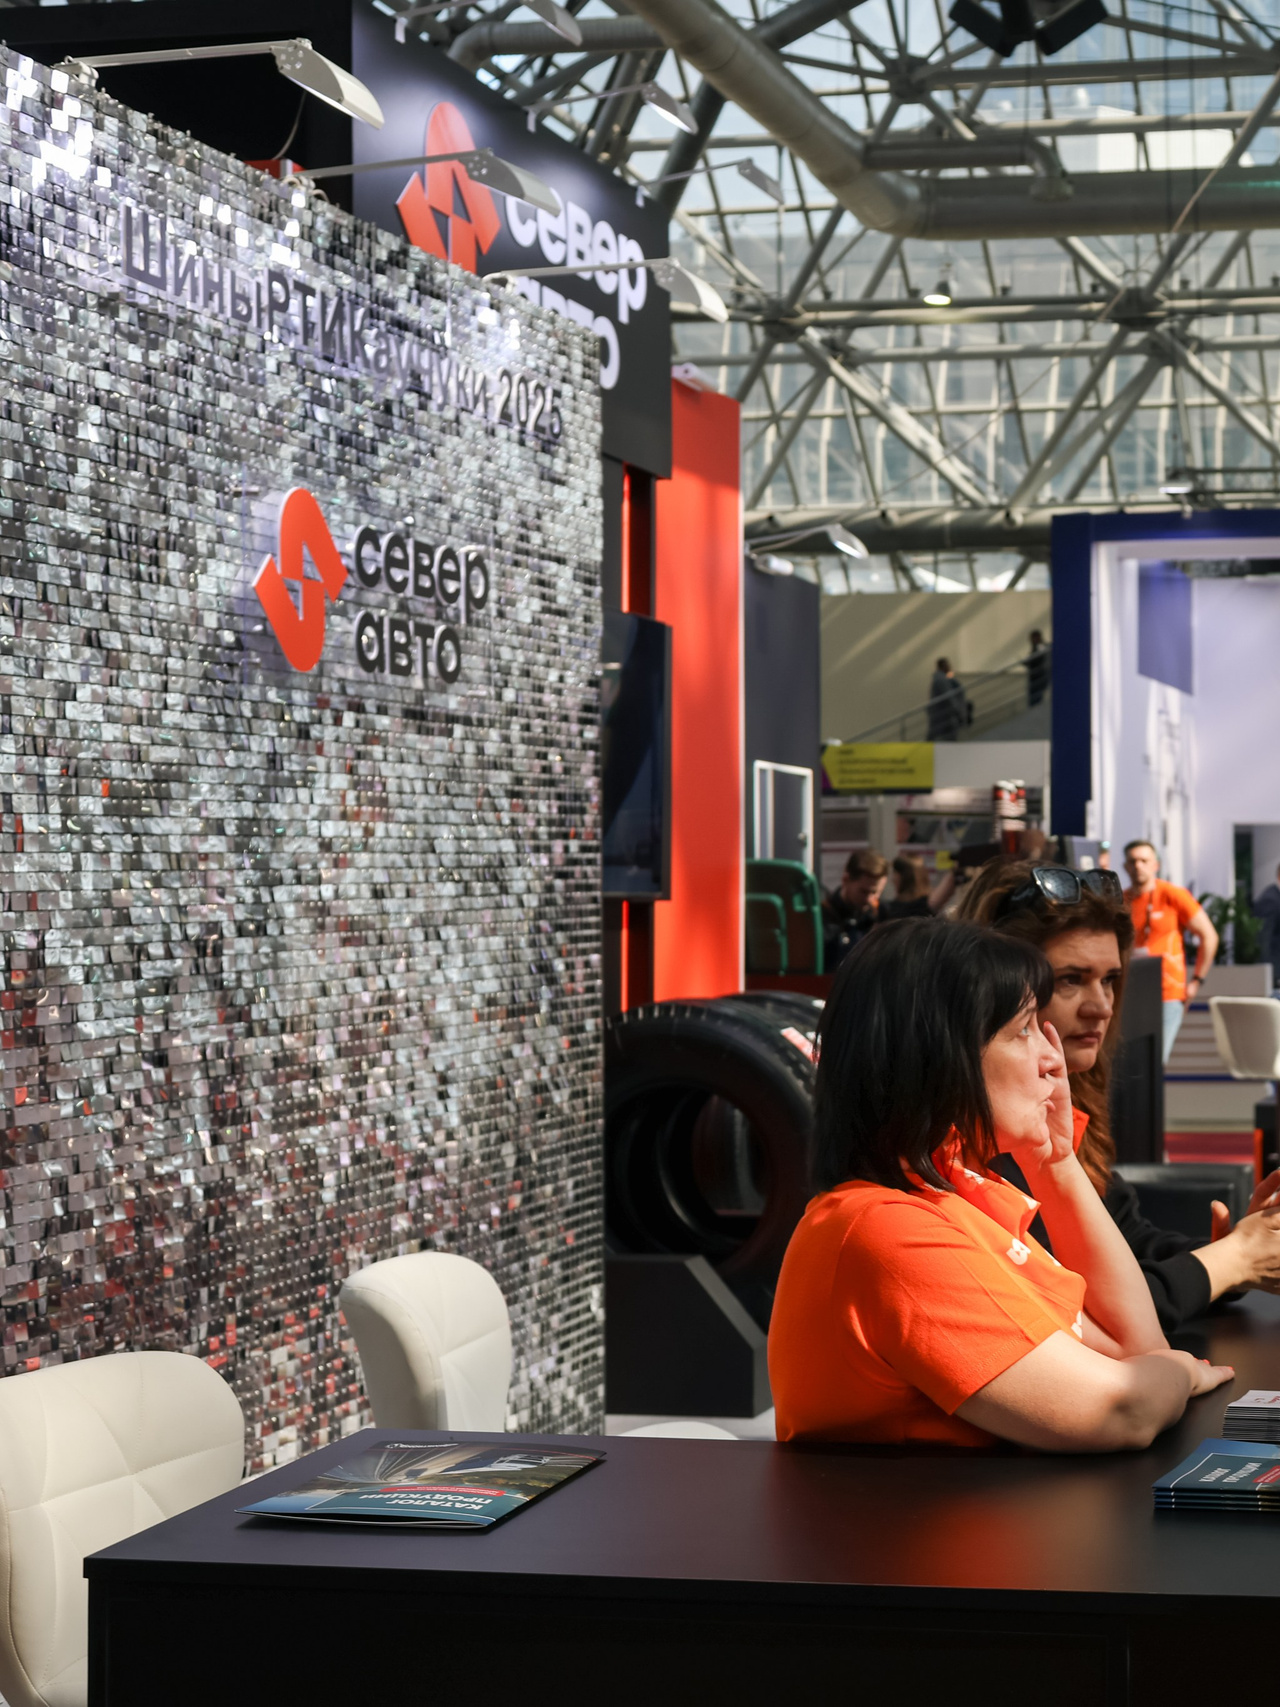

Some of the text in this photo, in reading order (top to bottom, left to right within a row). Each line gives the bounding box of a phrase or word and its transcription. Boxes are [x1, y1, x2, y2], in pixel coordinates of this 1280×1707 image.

[499, 369, 563, 439] 2025
[354, 525, 489, 625] север
[354, 610, 461, 684] авто
[359, 1493, 493, 1505] ПРОДУКЦИИ
[386, 1499, 484, 1511] КАТАЛОГ
